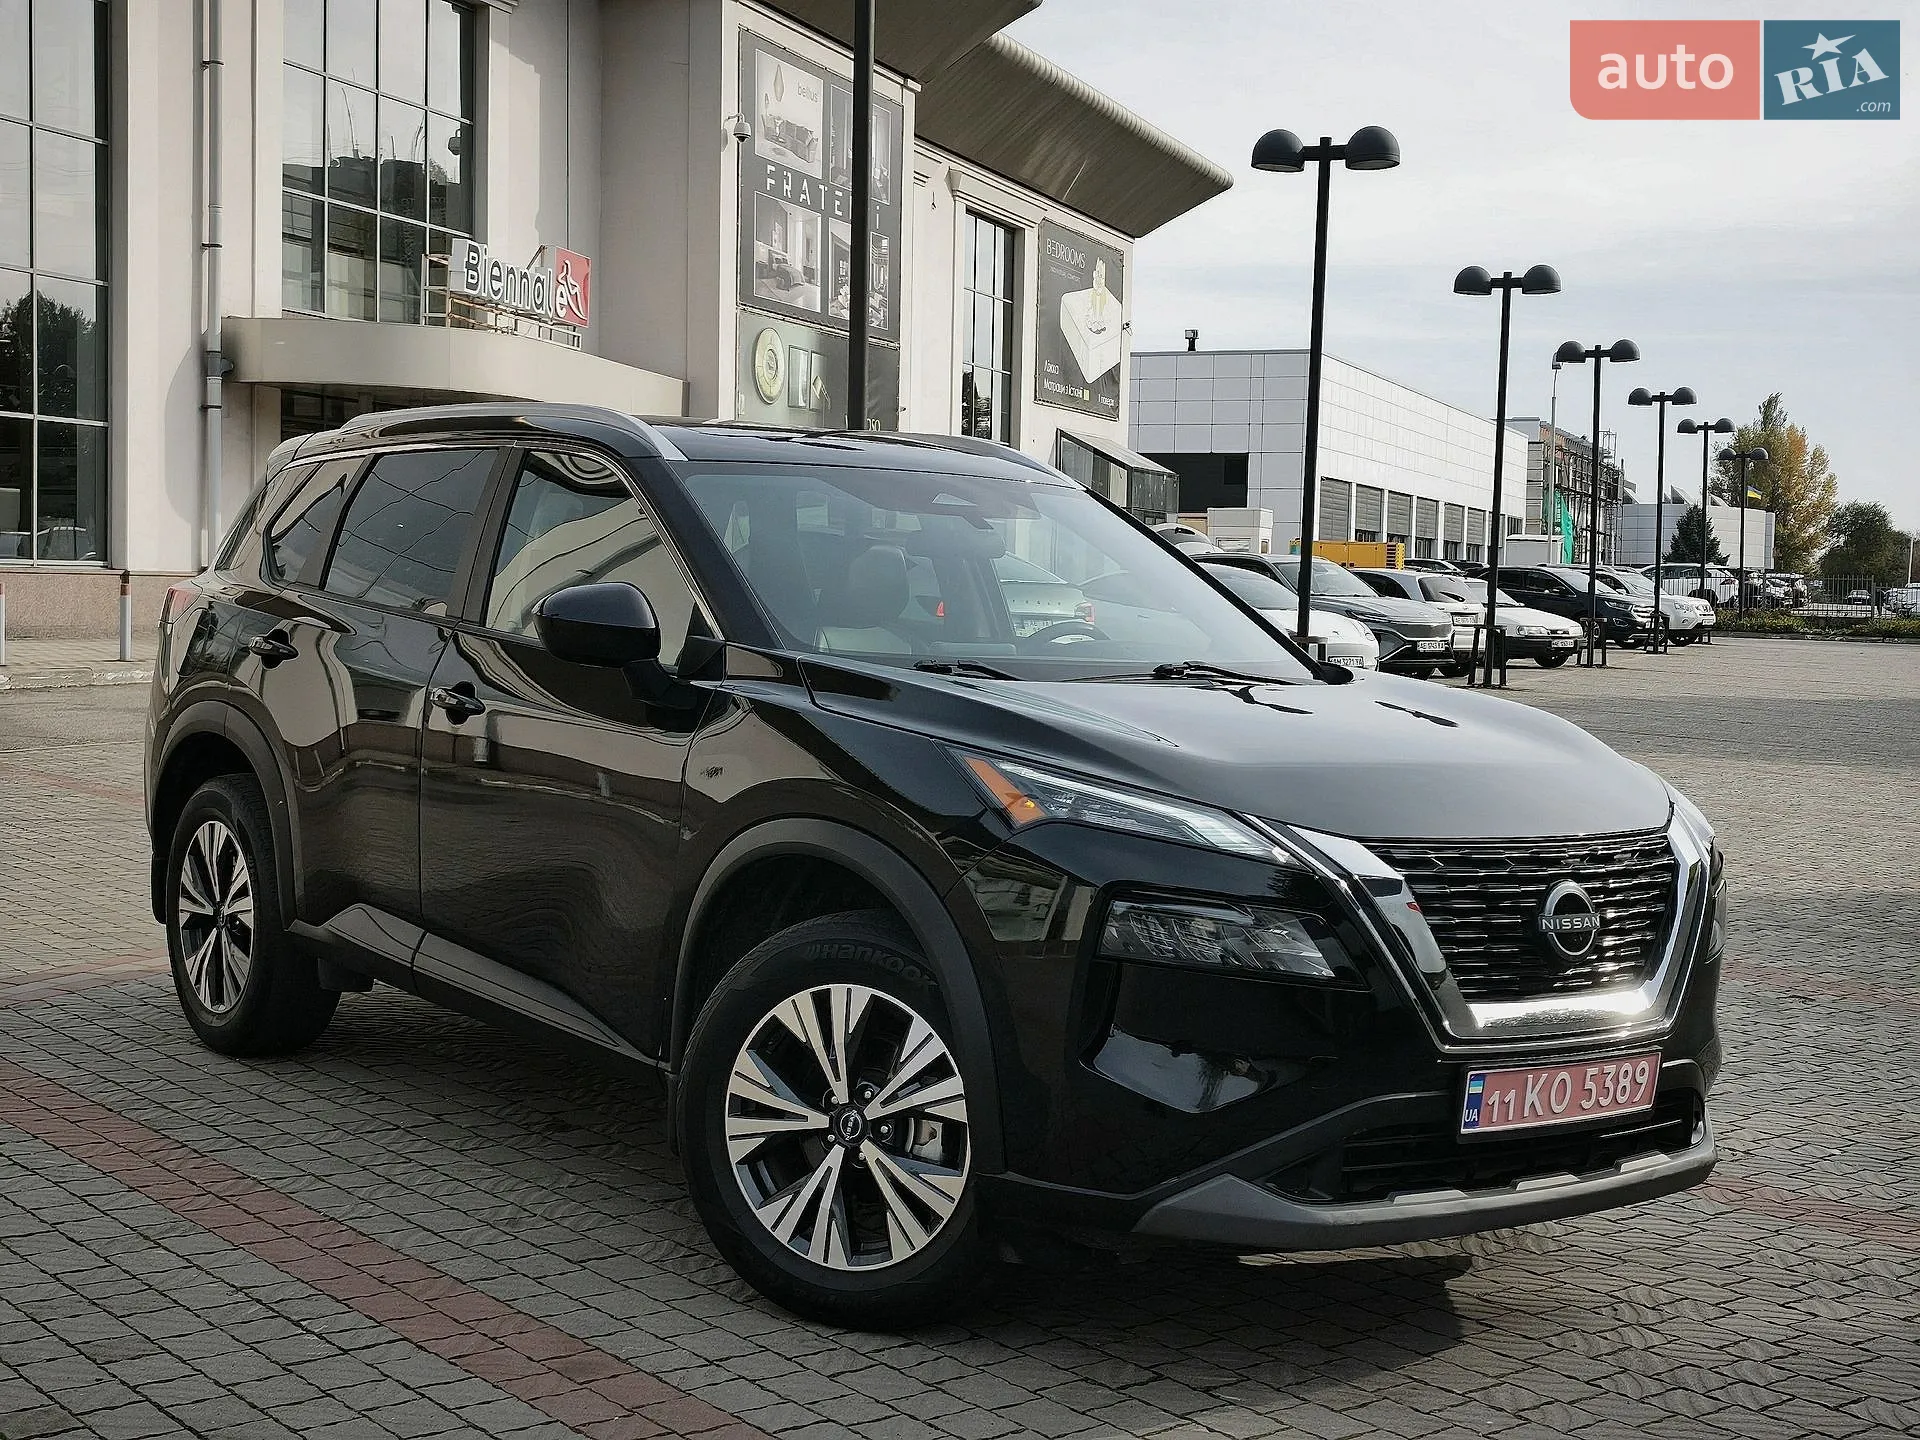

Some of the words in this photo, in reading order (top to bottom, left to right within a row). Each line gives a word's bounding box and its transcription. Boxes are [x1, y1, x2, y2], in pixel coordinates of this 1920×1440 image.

[1046, 238, 1086, 269] BEDROOMS
[464, 241, 568, 319] Biennale
[1541, 915, 1600, 930] NISSAN
[1465, 1108, 1478, 1122] UA
[1487, 1089, 1516, 1123] 11
[1523, 1071, 1572, 1119] KO
[1580, 1060, 1650, 1110] 5389
